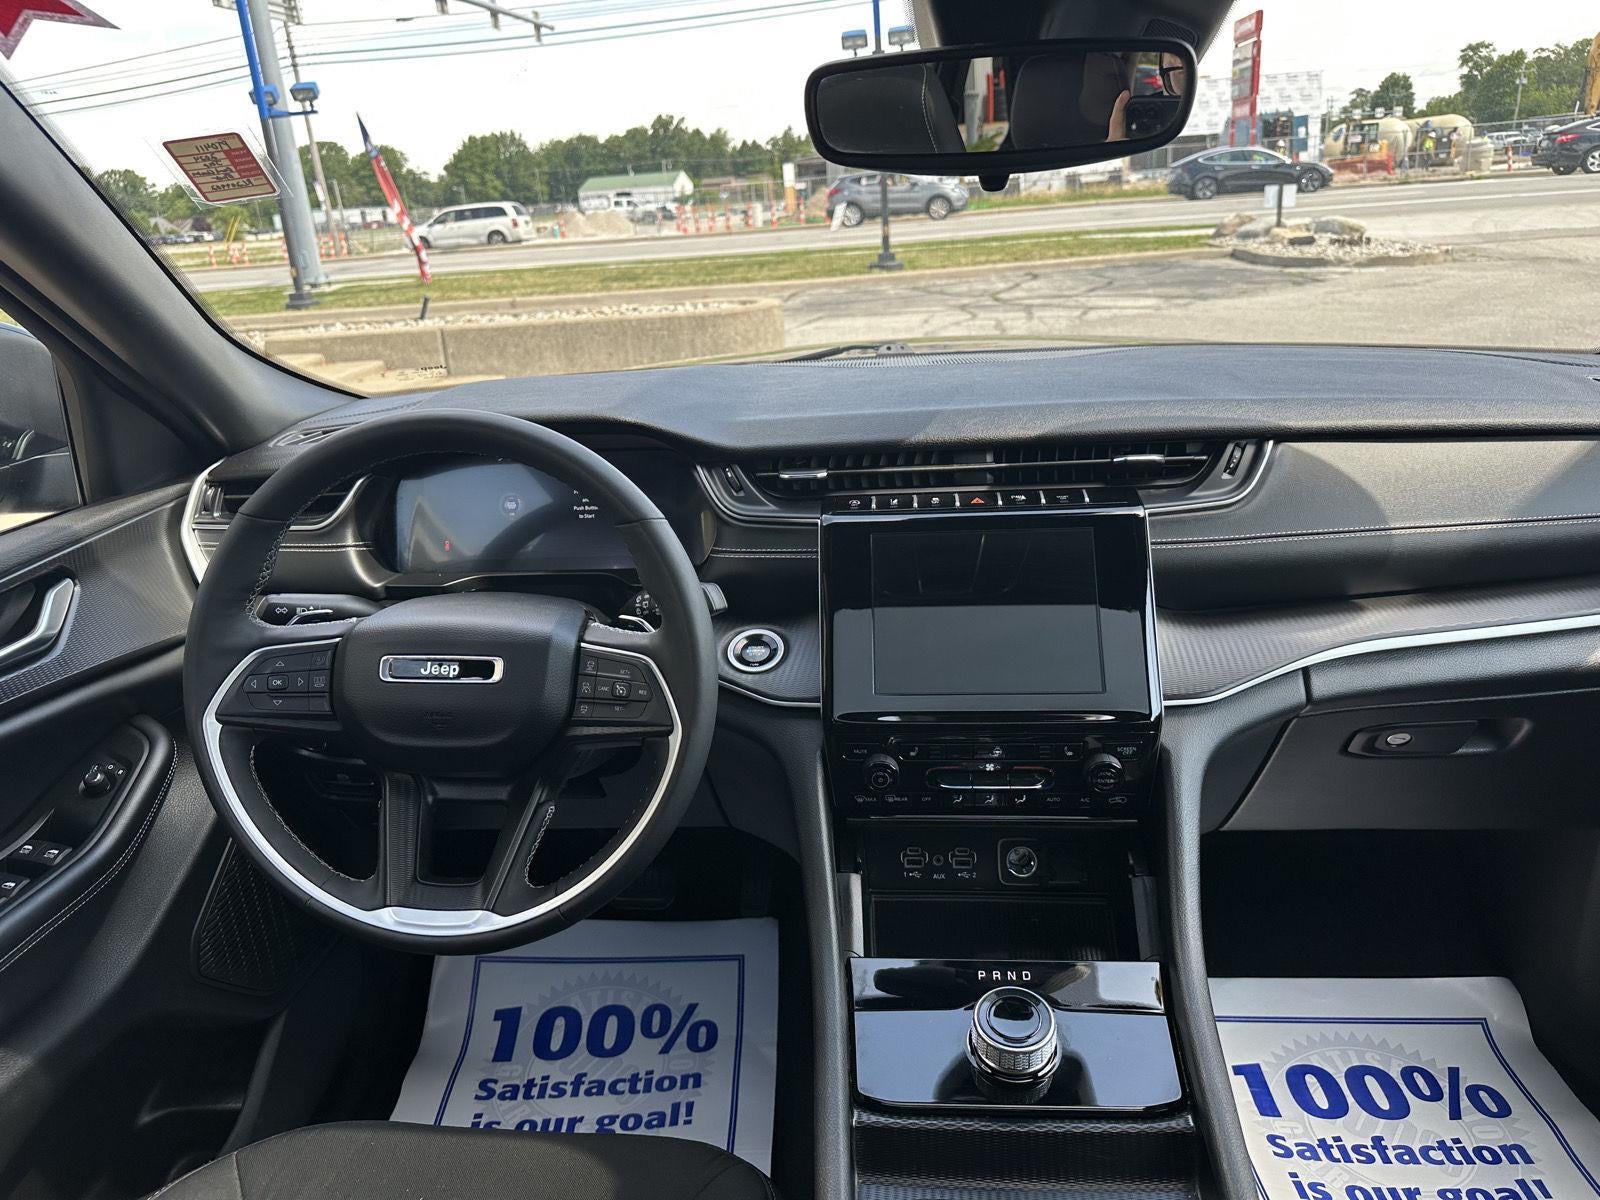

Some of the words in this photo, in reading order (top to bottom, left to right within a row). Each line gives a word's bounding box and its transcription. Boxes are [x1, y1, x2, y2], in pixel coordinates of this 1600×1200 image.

[420, 662, 460, 678] Jeep
[932, 872, 946, 880] AUX
[491, 1002, 719, 1063] 100%
[474, 1069, 702, 1101] Satisfaction
[1231, 1062, 1513, 1121] 100%
[514, 1116, 584, 1133] our
[595, 1101, 694, 1134] goal!
[1265, 1133, 1535, 1166] Satisfaction
[1287, 1172, 1333, 1200] is
[1344, 1184, 1421, 1200] our
